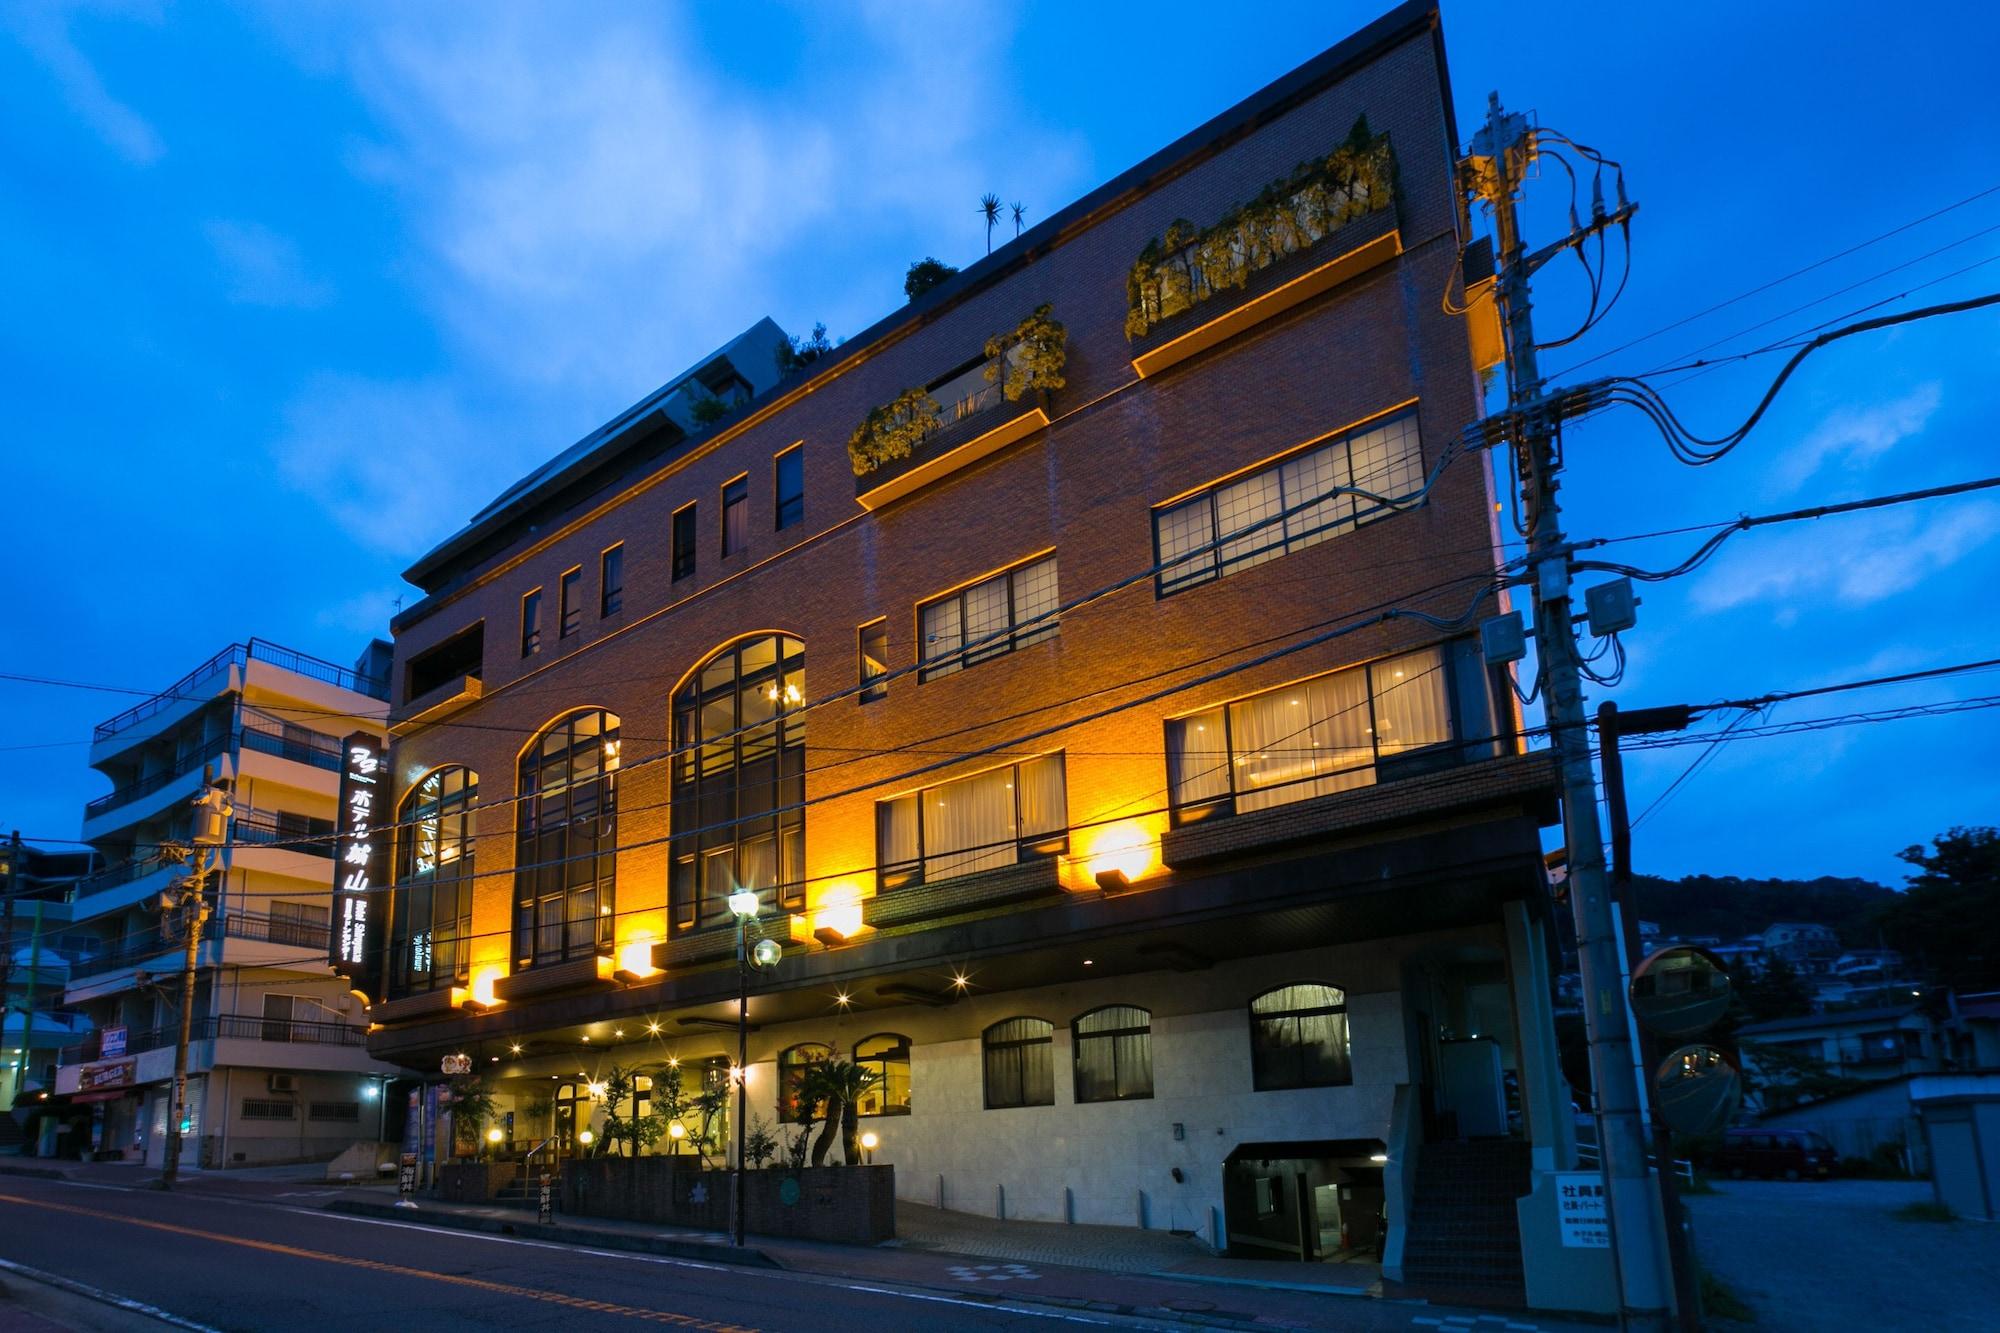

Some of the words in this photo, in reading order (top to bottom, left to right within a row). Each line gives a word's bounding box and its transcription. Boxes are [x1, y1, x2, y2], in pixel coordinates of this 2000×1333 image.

[344, 790, 373, 892] ホテル城山
[355, 900, 367, 921] Hotel
